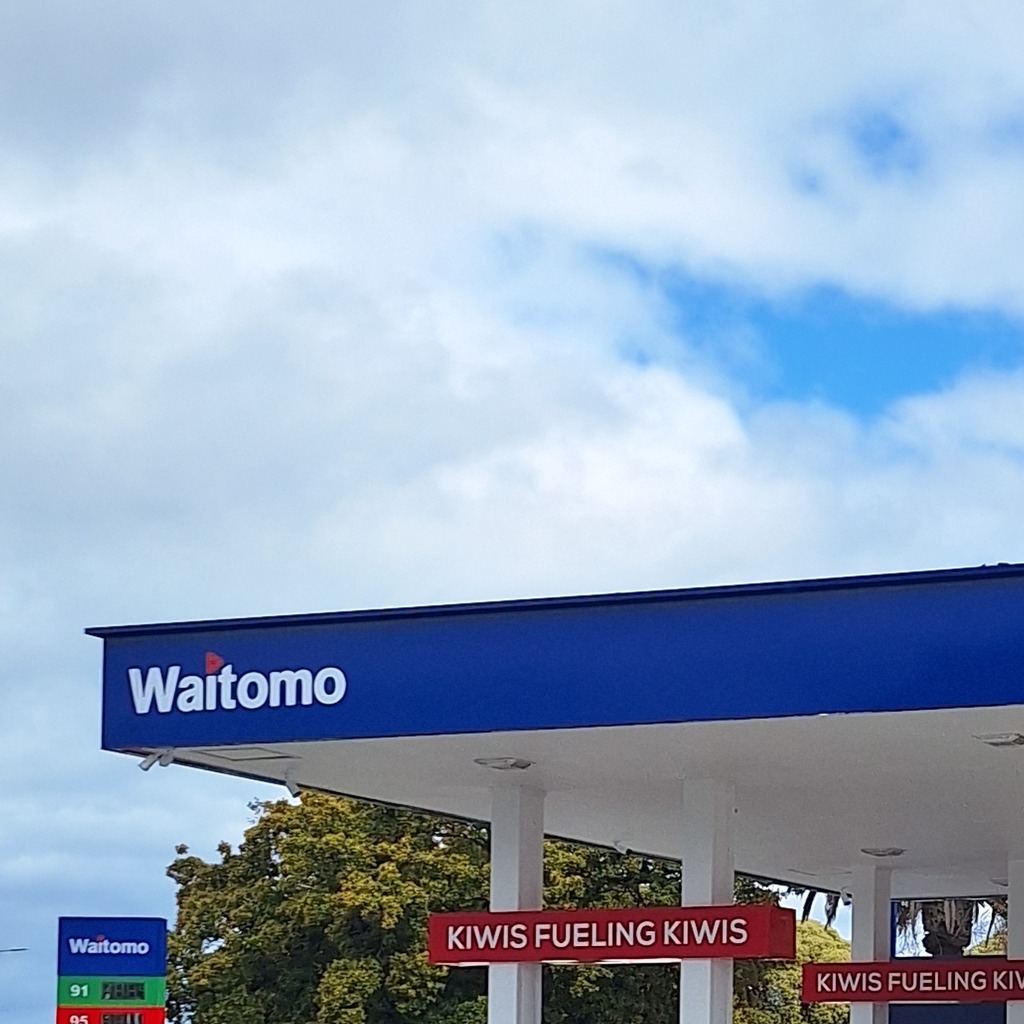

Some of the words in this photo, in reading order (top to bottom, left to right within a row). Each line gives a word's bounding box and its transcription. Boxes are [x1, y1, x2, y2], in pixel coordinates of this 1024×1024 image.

[128, 652, 347, 714] Waitomo
[69, 935, 150, 954] Waitomo
[448, 924, 527, 950] KIWIS
[535, 920, 655, 948] FUELING
[663, 918, 748, 944] KIWIS
[70, 984, 88, 997] 91
[817, 972, 882, 992] KIWIS
[888, 971, 986, 991] FUELING
